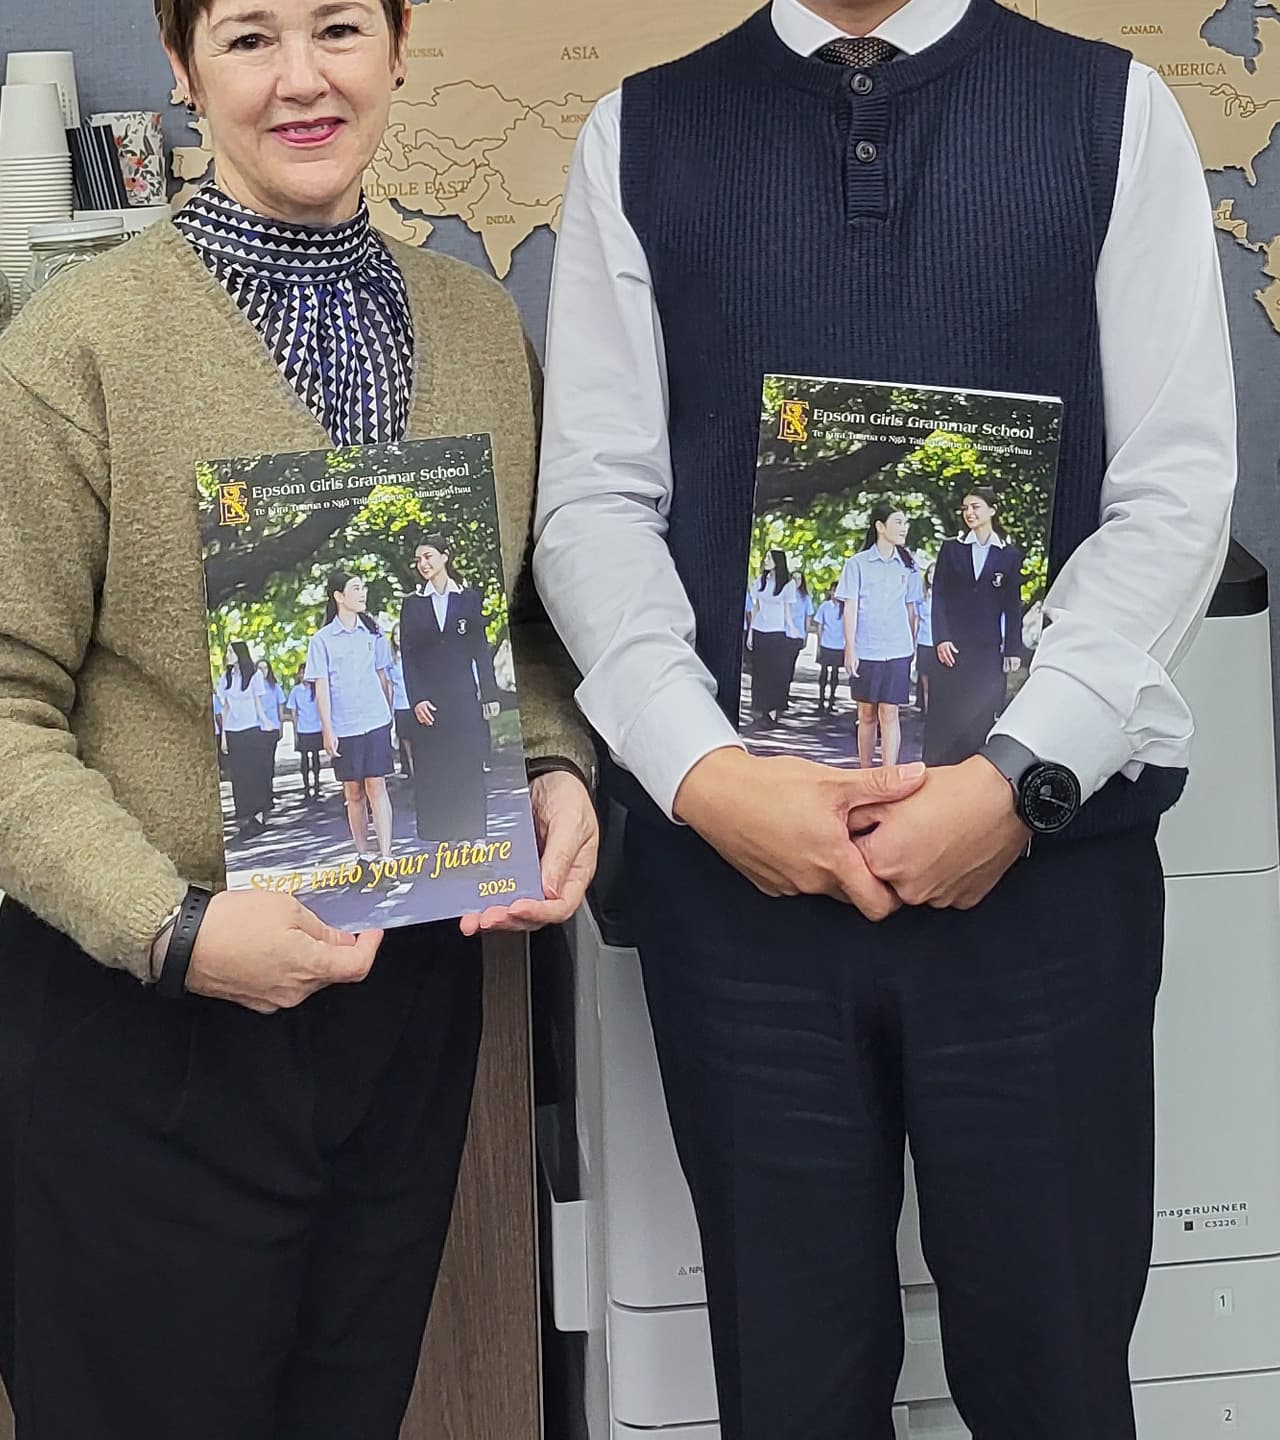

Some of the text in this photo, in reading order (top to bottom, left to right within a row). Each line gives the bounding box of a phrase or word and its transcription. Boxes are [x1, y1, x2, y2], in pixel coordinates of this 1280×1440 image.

[1121, 25, 1162, 35] CANADA
[406, 48, 443, 58] RUSSIA
[561, 46, 599, 60] ASIA
[1157, 63, 1226, 77] AMERICA
[425, 180, 469, 195] EAST
[486, 215, 515, 224] INDIA
[813, 409, 1034, 439] Epsom Girls Grammar School
[252, 463, 470, 500] Epsom Girls Grammar School
[311, 859, 362, 890] into
[368, 851, 430, 888] your
[430, 840, 513, 879] future
[478, 877, 517, 898] 2025
[1204, 1219, 1237, 1228] C3226
[1218, 1293, 1227, 1308] 1
[1223, 1408, 1233, 1423] 2
